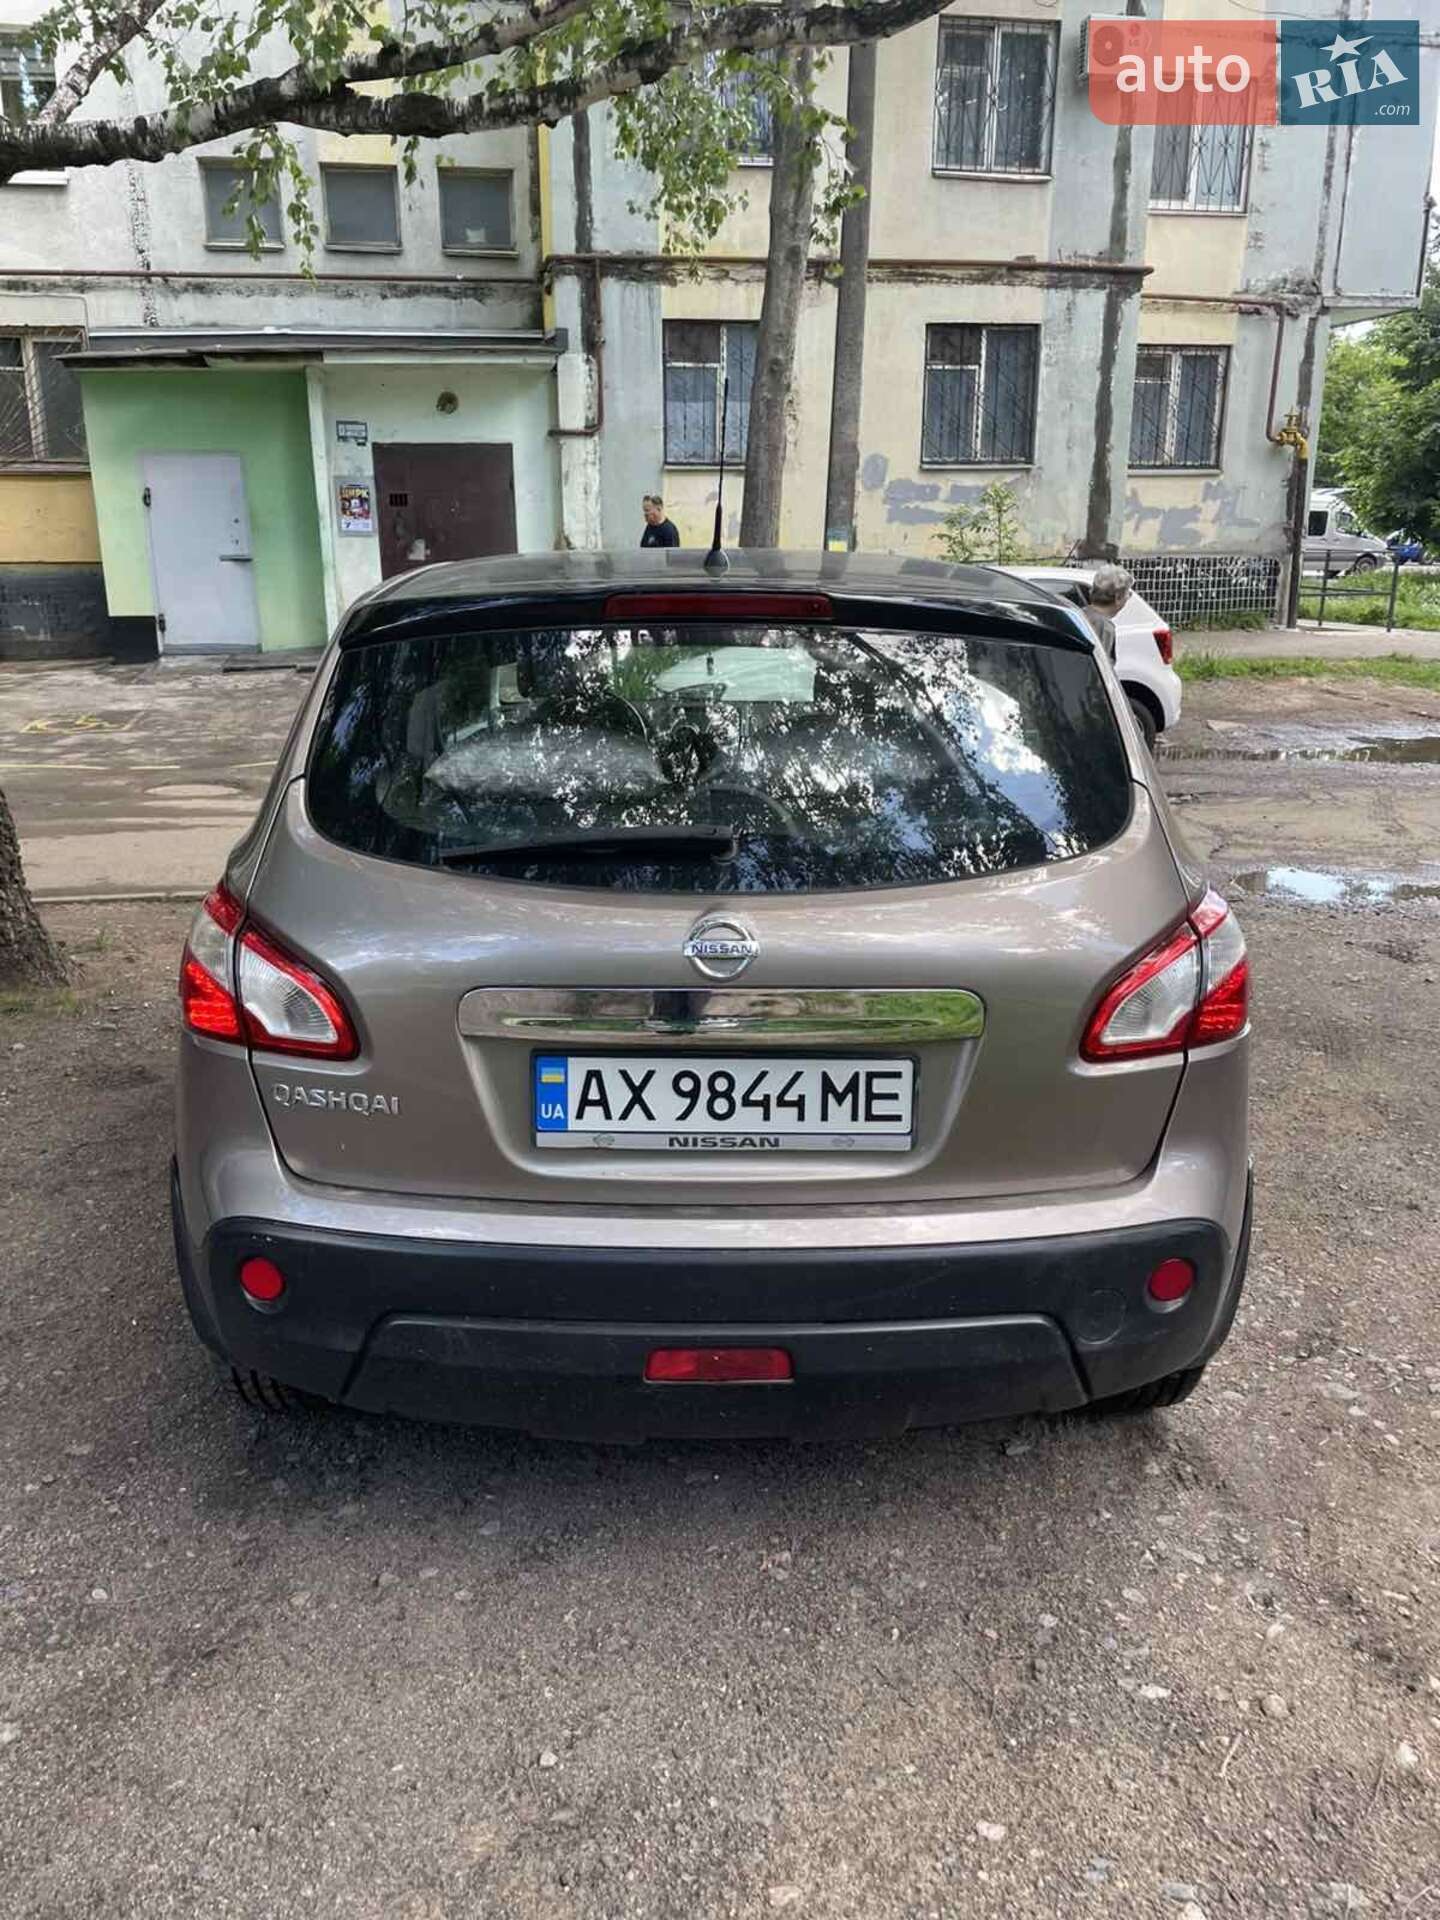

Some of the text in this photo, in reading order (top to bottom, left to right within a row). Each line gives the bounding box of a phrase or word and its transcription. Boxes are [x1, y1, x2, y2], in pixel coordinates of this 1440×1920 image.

[691, 943, 753, 954] NISSAN
[273, 1083, 400, 1116] QASHQAI
[575, 1069, 903, 1122] AX 9844 ME
[541, 1103, 564, 1120] UA
[668, 1136, 780, 1149] NISSAN
